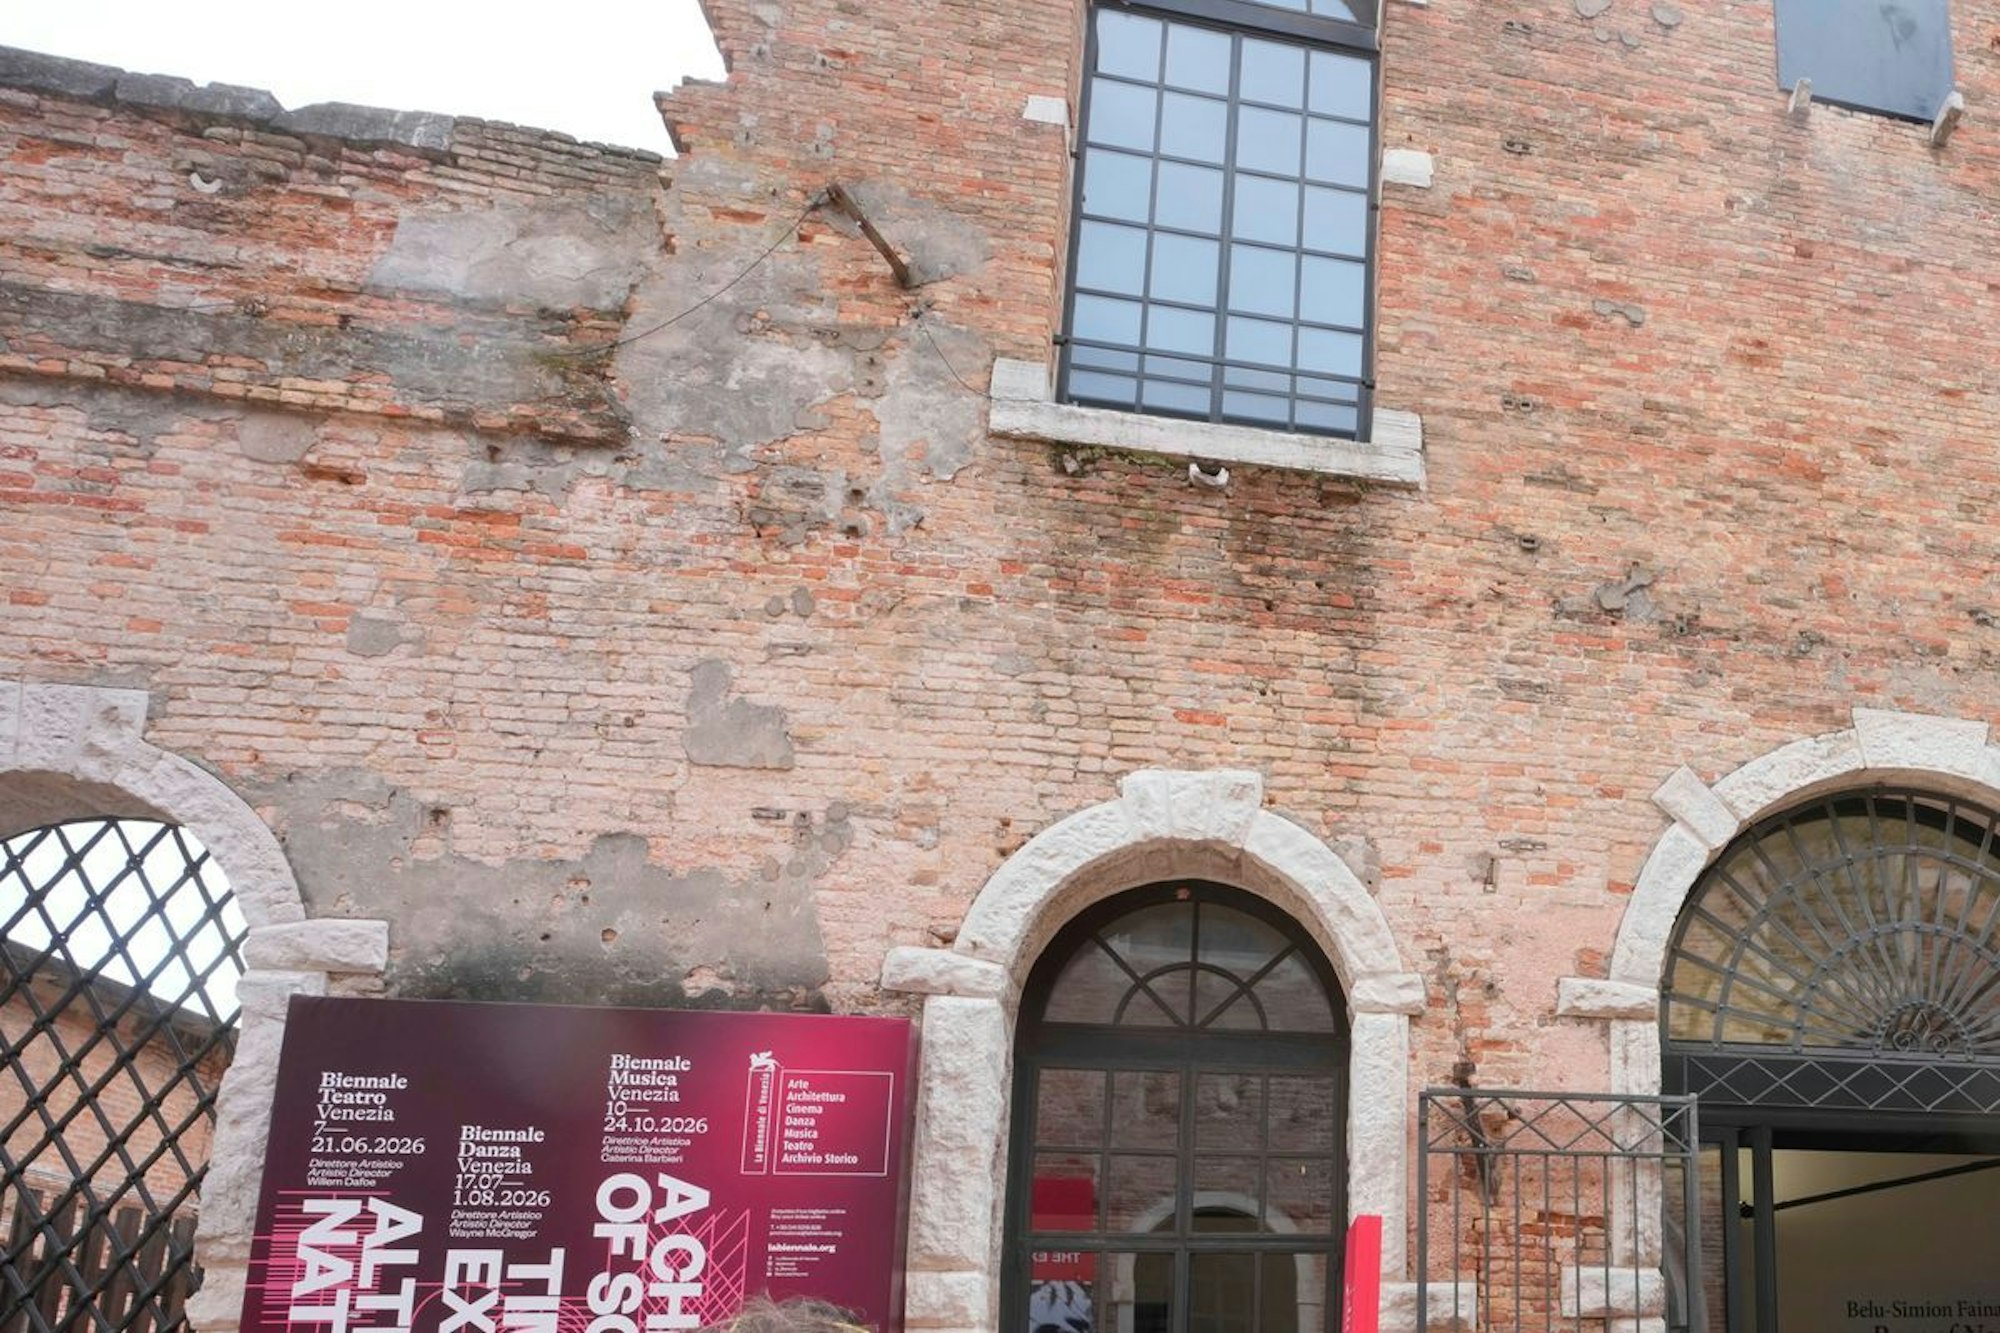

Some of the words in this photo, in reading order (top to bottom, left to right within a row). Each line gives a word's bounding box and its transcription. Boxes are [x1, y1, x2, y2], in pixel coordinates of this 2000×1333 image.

[610, 1054, 691, 1071] Biennale
[320, 1072, 408, 1089] Biennale
[608, 1070, 677, 1086] Musica
[787, 1079, 809, 1089] Arte
[318, 1088, 387, 1105] Teatro
[608, 1085, 680, 1102] Venezia
[759, 1073, 771, 1104] Venezia
[786, 1091, 846, 1102] Architettura
[317, 1104, 395, 1121] Venezia
[786, 1104, 823, 1114] Cinema
[603, 1117, 708, 1134] 24.10.2026
[785, 1116, 816, 1127] Danza
[461, 1125, 545, 1142] Biennale
[602, 1136, 649, 1145] Direttrice
[650, 1137, 691, 1146] Artistica
[754, 1117, 767, 1153] Biennale
[784, 1128, 818, 1139] Musica
[310, 1137, 425, 1154] 21.06.2026
[458, 1141, 521, 1157] Danza
[601, 1145, 638, 1154] Artistic
[639, 1146, 680, 1155] Director
[783, 1140, 814, 1151] Teatro
[309, 1158, 358, 1168] Direttore
[358, 1159, 403, 1169] Artistico
[457, 1157, 533, 1174] Venezia
[600, 1153, 643, 1162] Caterina
[781, 1153, 822, 1164] Archivio
[824, 1153, 859, 1164] Storico
[307, 1168, 348, 1177] Artistic
[349, 1168, 392, 1177] Director
[307, 1177, 343, 1186] Willem
[344, 1178, 376, 1186] Dafoe
[453, 1190, 551, 1207] 1.08.2026
[654, 1172, 711, 1224] A
[451, 1209, 497, 1219] Direttore
[498, 1210, 543, 1220] Artistico
[593, 1173, 653, 1261] OF
[449, 1219, 488, 1228] Artistic
[489, 1219, 532, 1229] Director
[449, 1228, 484, 1238] Wayne
[485, 1229, 538, 1240] McGregor
[768, 1243, 836, 1254] labiennale.org
[352, 1196, 424, 1333] ALT
[646, 1234, 706, 1333] CH
[1847, 1300, 1952, 1318] Belu-Simion
